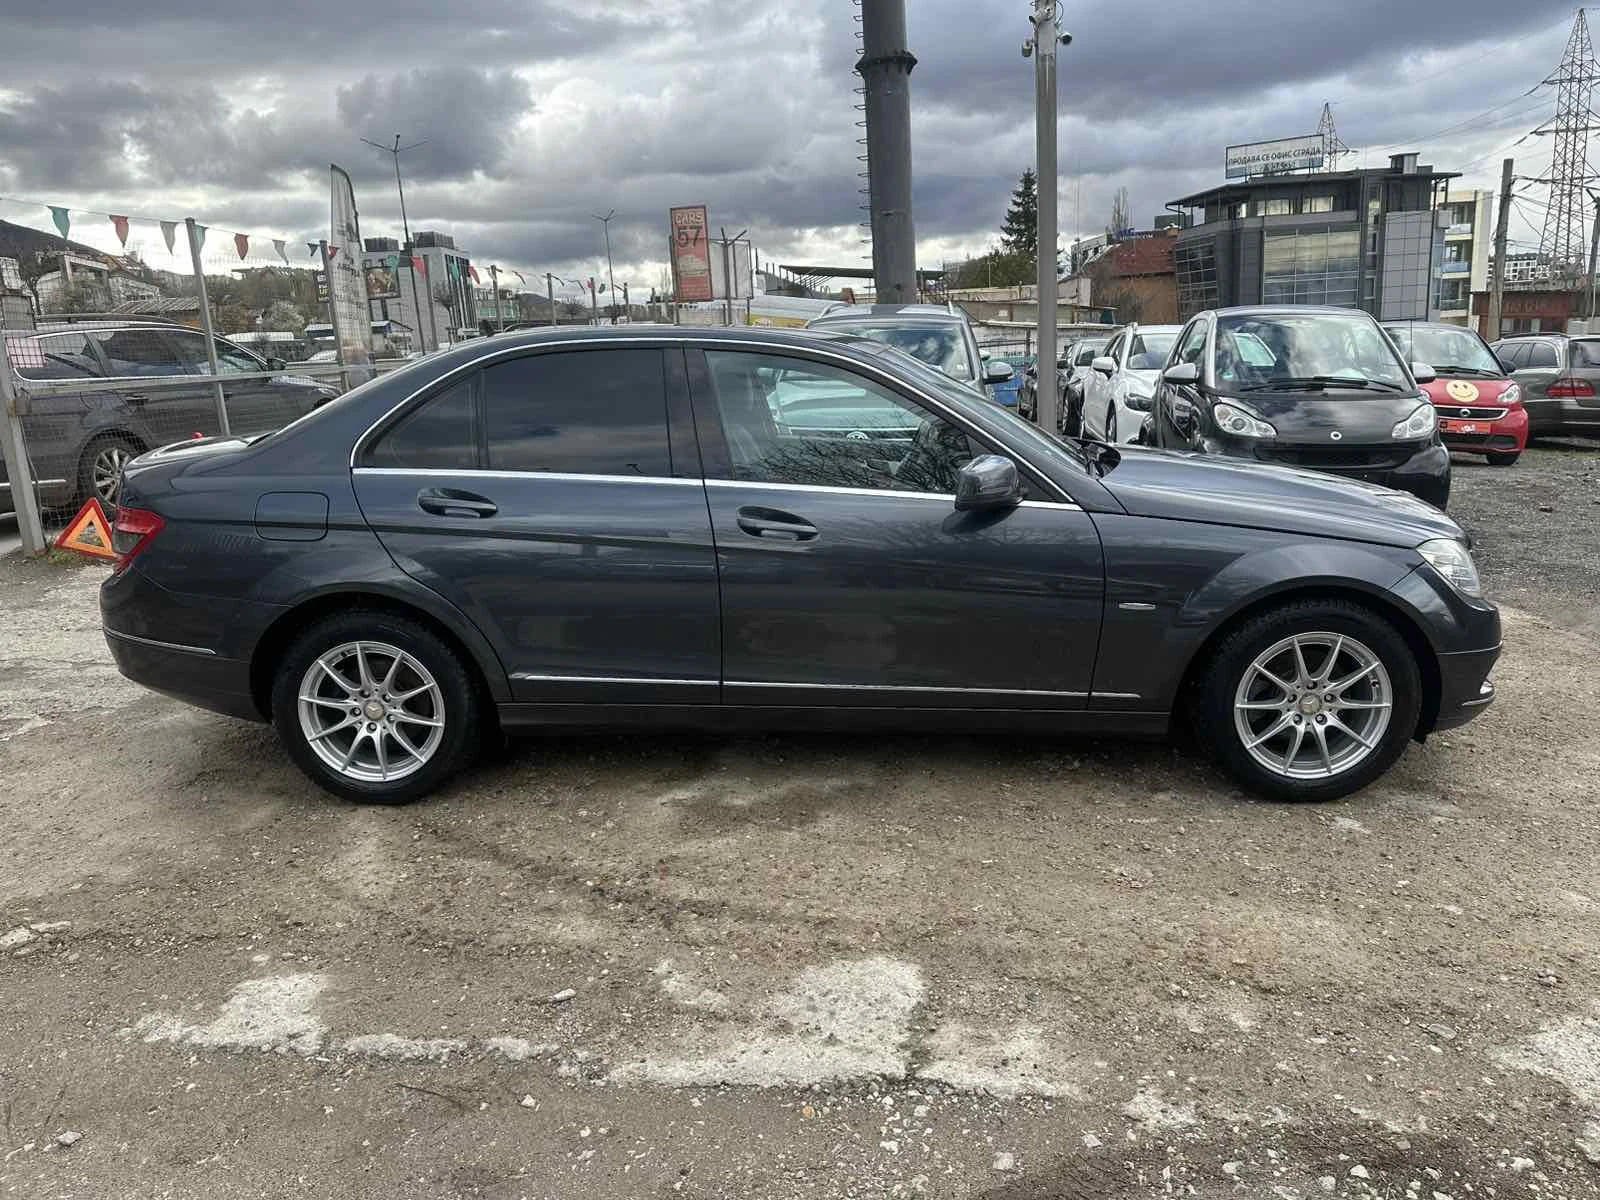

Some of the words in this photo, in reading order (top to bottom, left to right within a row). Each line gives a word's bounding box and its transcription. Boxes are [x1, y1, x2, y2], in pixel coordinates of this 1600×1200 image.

[1261, 153, 1271, 162] СЕ
[1271, 151, 1292, 160] ОФИС
[673, 211, 704, 225] CARS
[678, 225, 703, 248] 57
